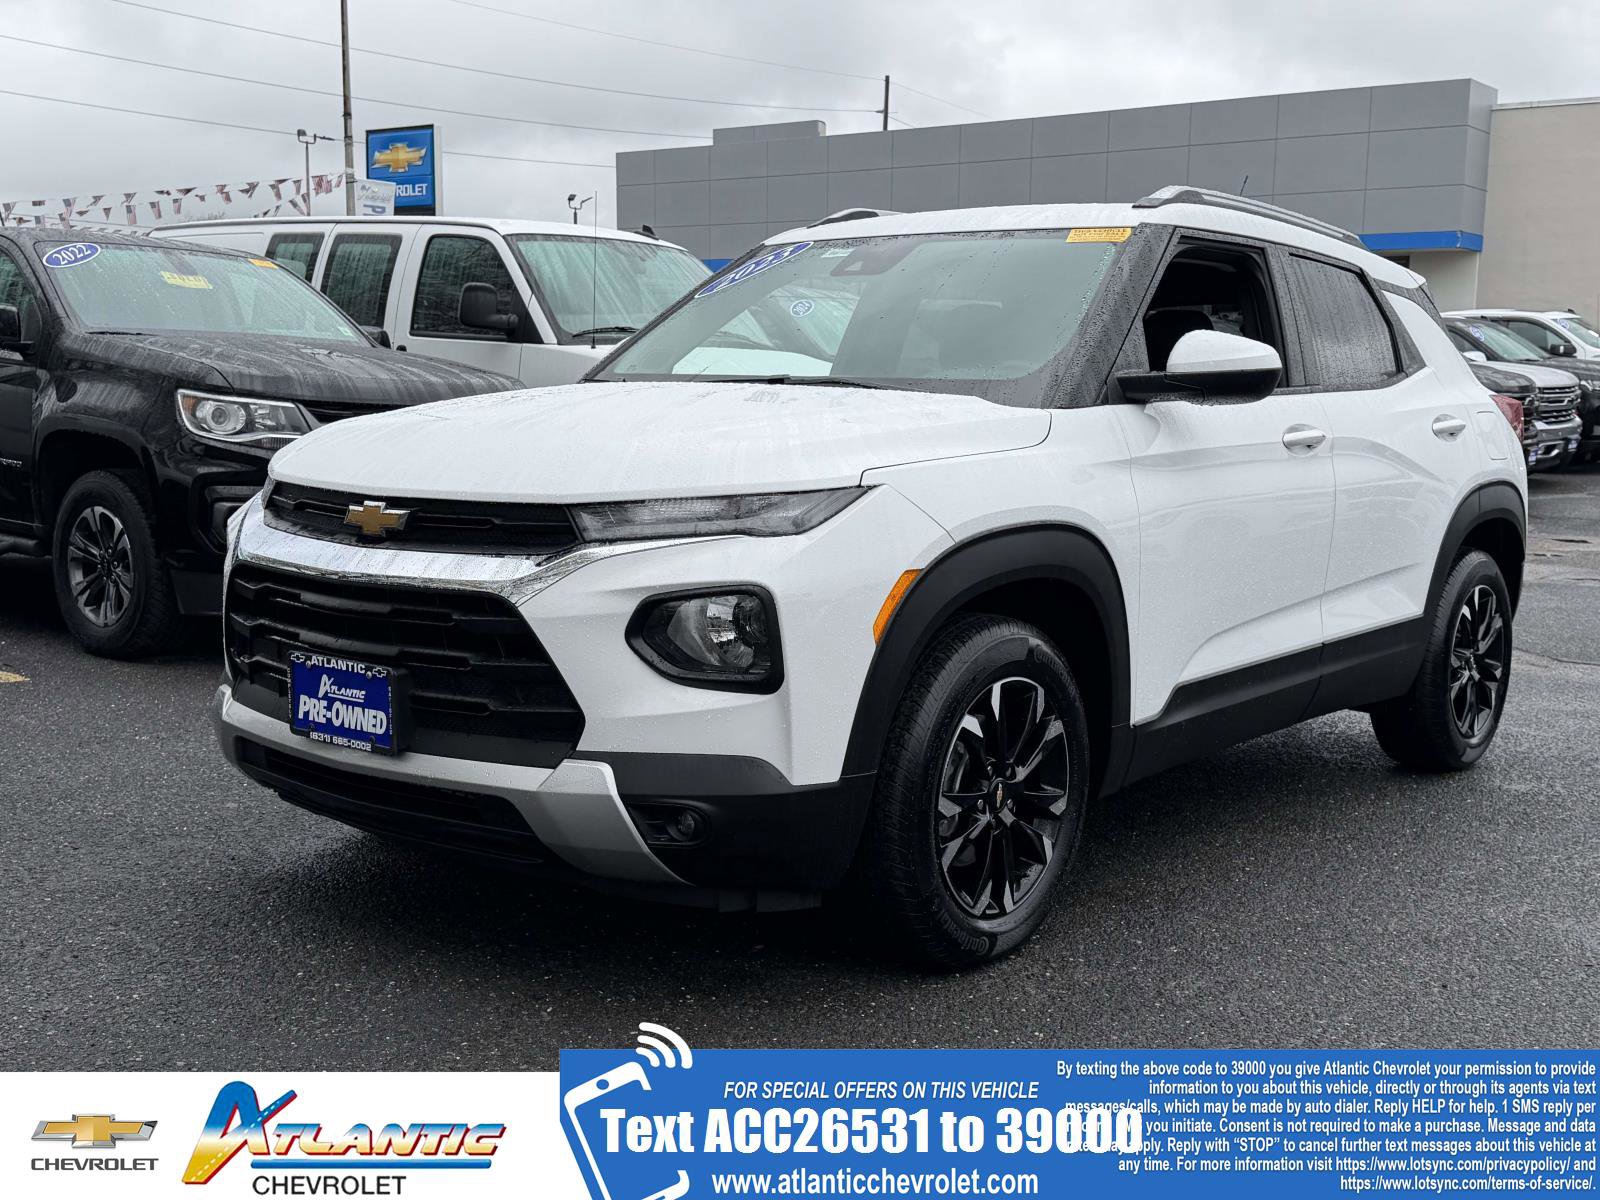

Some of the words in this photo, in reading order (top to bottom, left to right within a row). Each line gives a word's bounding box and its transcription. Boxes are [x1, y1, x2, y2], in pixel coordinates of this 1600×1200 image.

[396, 184, 428, 196] ROLET
[53, 245, 91, 265] 2022
[714, 246, 793, 292] 2023
[311, 656, 366, 674] ATLANTIC
[318, 674, 366, 699] ATLANTIC
[298, 695, 388, 735] PRE-OWNED
